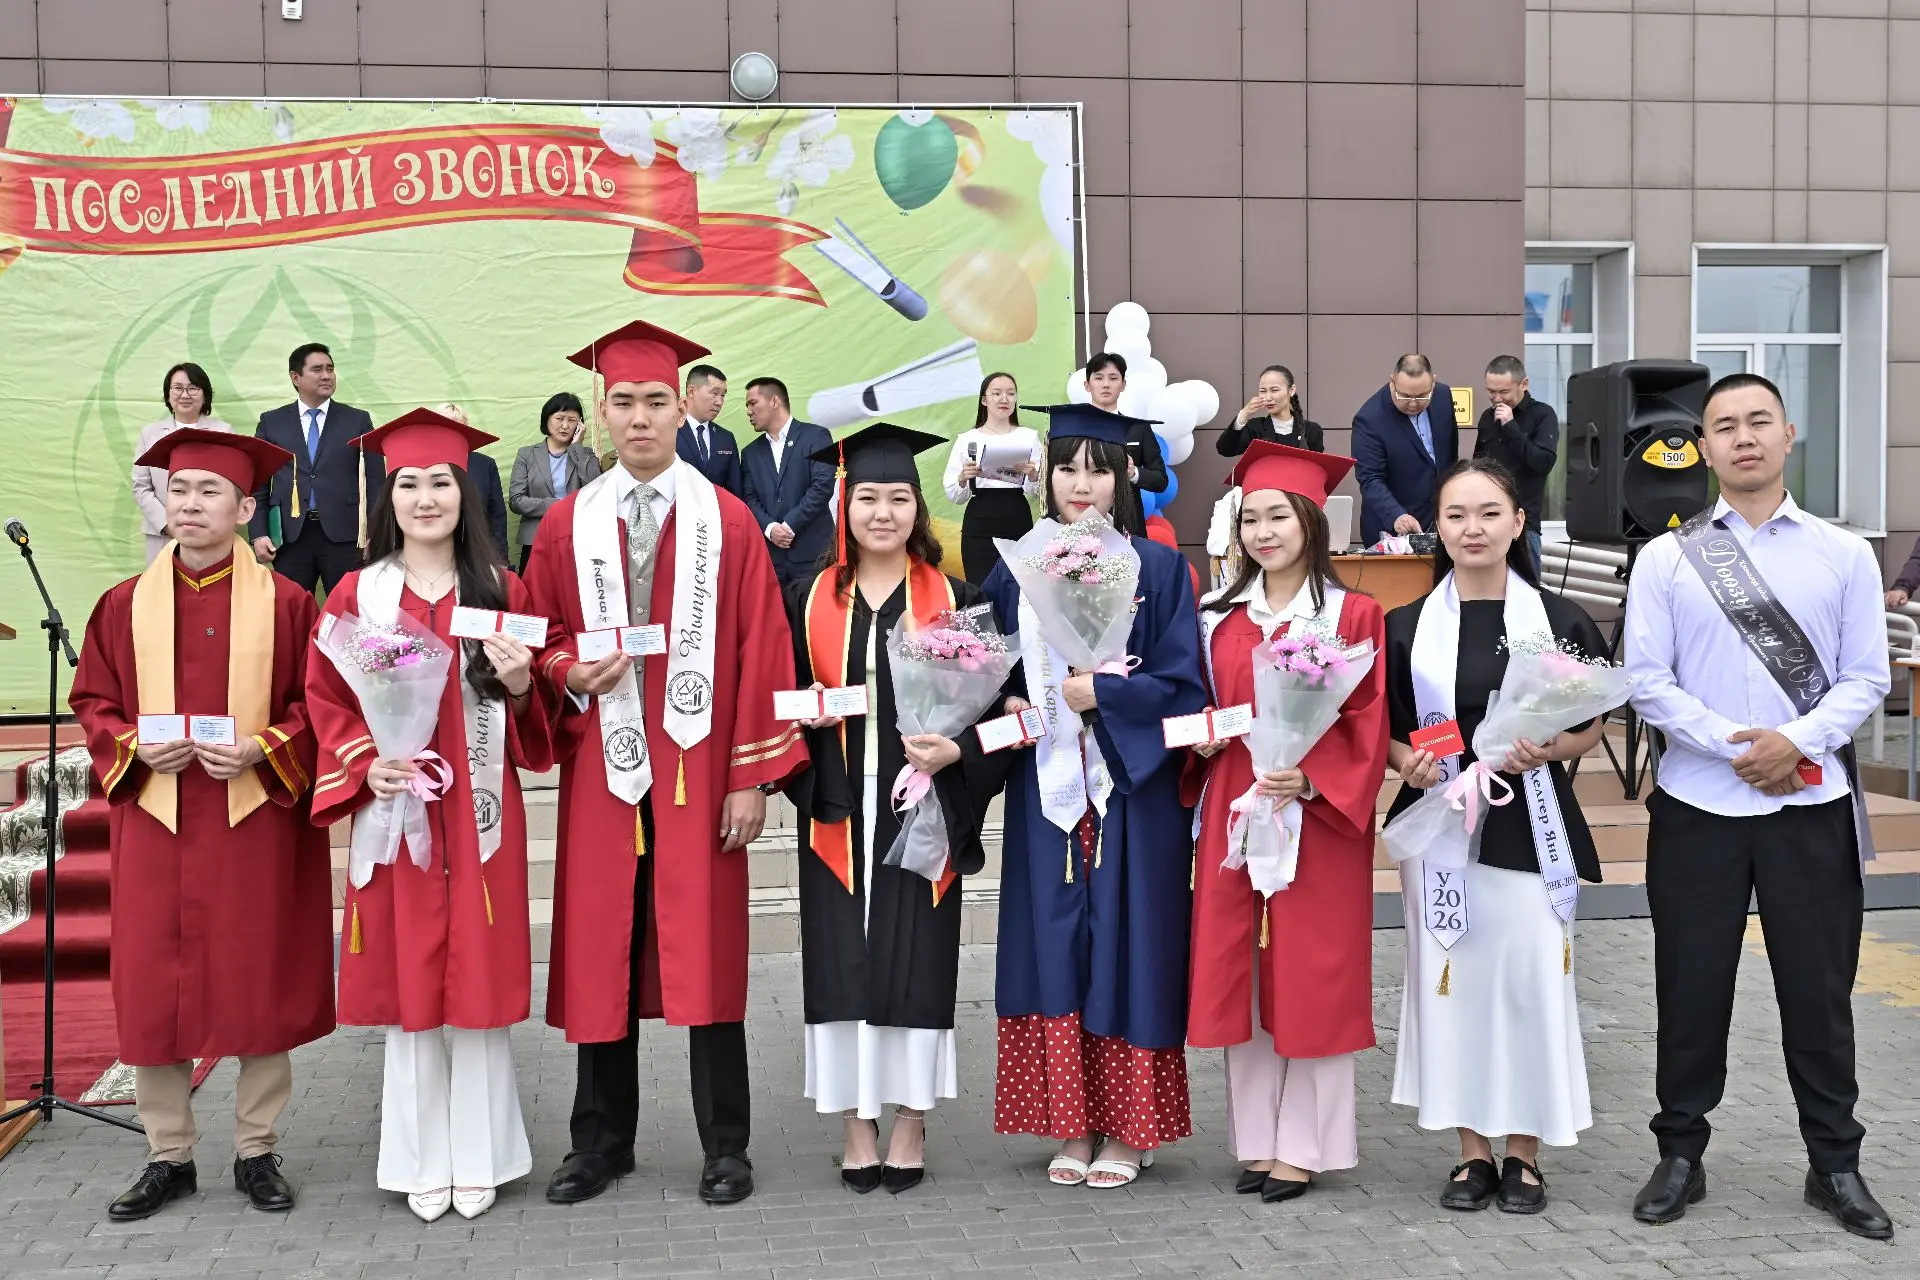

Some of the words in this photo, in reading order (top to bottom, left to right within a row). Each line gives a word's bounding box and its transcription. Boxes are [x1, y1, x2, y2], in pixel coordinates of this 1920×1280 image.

[31, 147, 379, 235] ПОСЛЕДНИЙ
[392, 143, 617, 206] ЗВОНОК
[1661, 452, 1686, 462] 1500
[593, 566, 608, 615] 2026
[679, 517, 710, 659] Выпускник
[467, 697, 497, 776] Выпу
[1544, 830, 1559, 864] Яна
[1432, 888, 1461, 908] 20
[1433, 910, 1462, 930] 26
